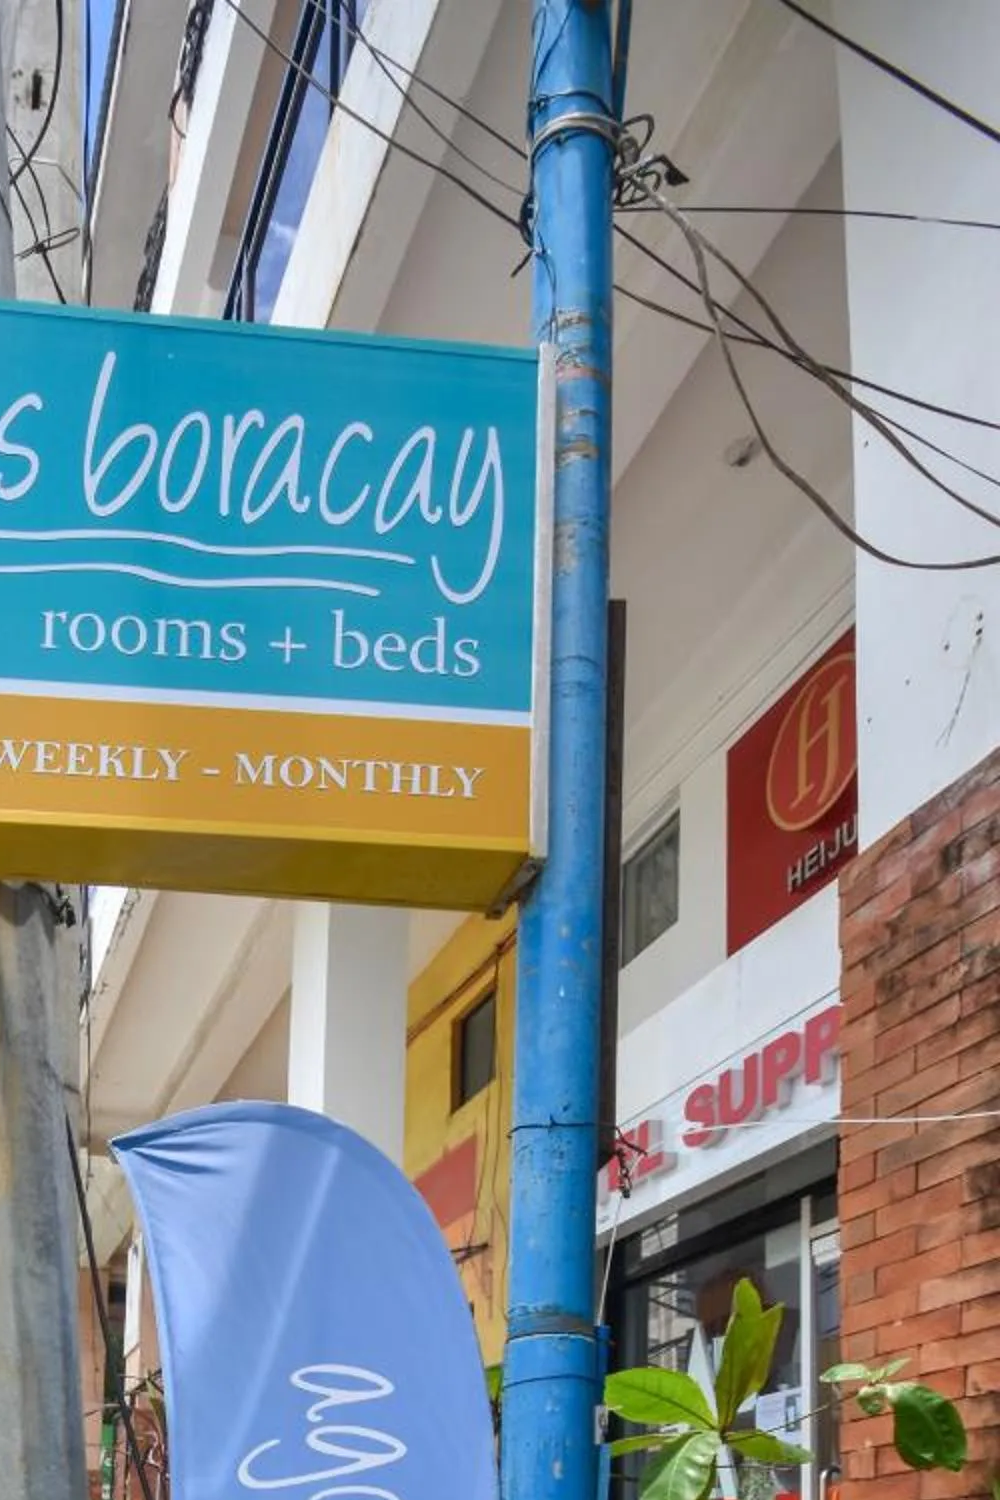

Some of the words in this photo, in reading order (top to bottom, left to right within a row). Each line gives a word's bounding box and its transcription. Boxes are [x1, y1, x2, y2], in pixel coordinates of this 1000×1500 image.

[82, 350, 504, 604] boracay
[41, 607, 247, 664] rooms
[269, 626, 308, 666] +
[334, 610, 482, 678] beds
[236, 752, 485, 800] MONTHLY
